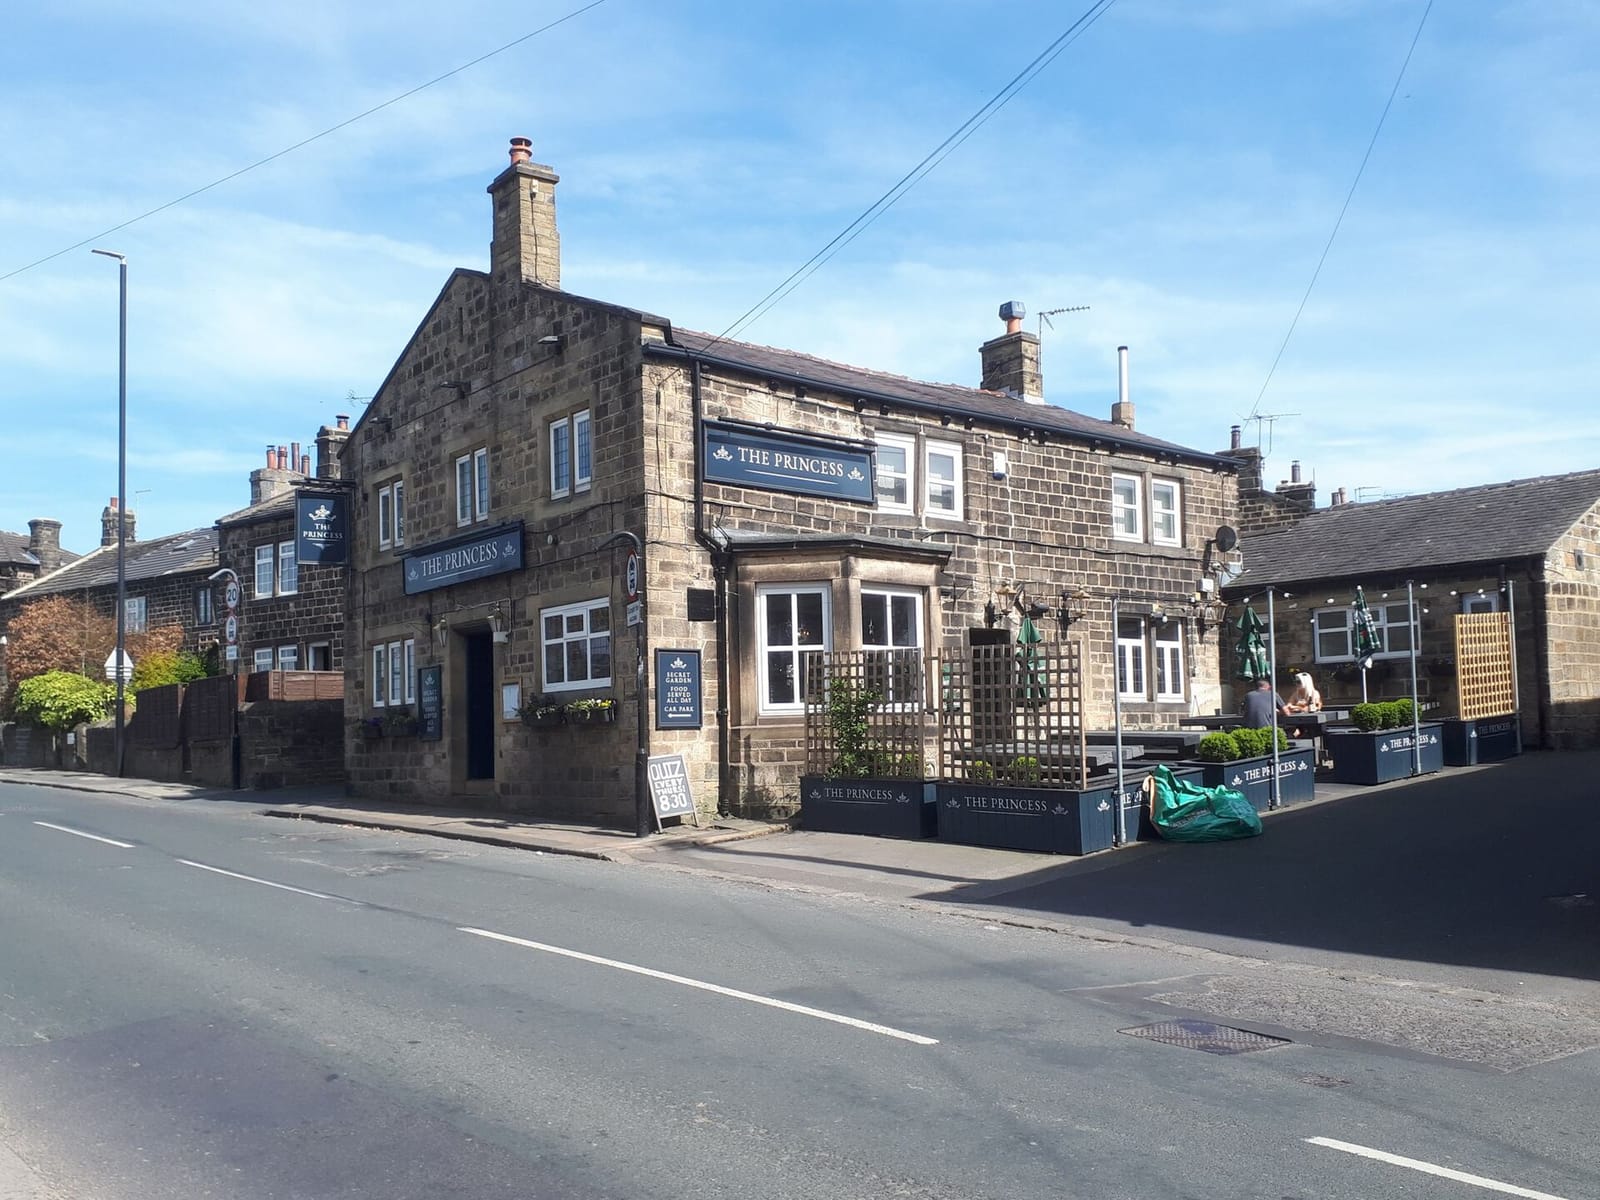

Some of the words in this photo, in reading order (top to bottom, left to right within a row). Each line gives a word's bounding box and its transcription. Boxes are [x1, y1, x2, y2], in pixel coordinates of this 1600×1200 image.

[737, 446, 770, 466] THE
[774, 452, 844, 477] PRINCESS
[303, 530, 343, 539] PRINCESS
[421, 556, 442, 577] THE
[445, 541, 498, 571] PRINCESS
[227, 588, 237, 602] 20
[1390, 738, 1402, 749] THE
[650, 760, 685, 781] QUIZ
[1243, 768, 1261, 781] THE
[654, 777, 683, 789] EVERY
[824, 787, 844, 798] THE
[846, 788, 893, 800] PRINCESS
[964, 796, 988, 809] THE
[991, 797, 1048, 812] PRINCESS
